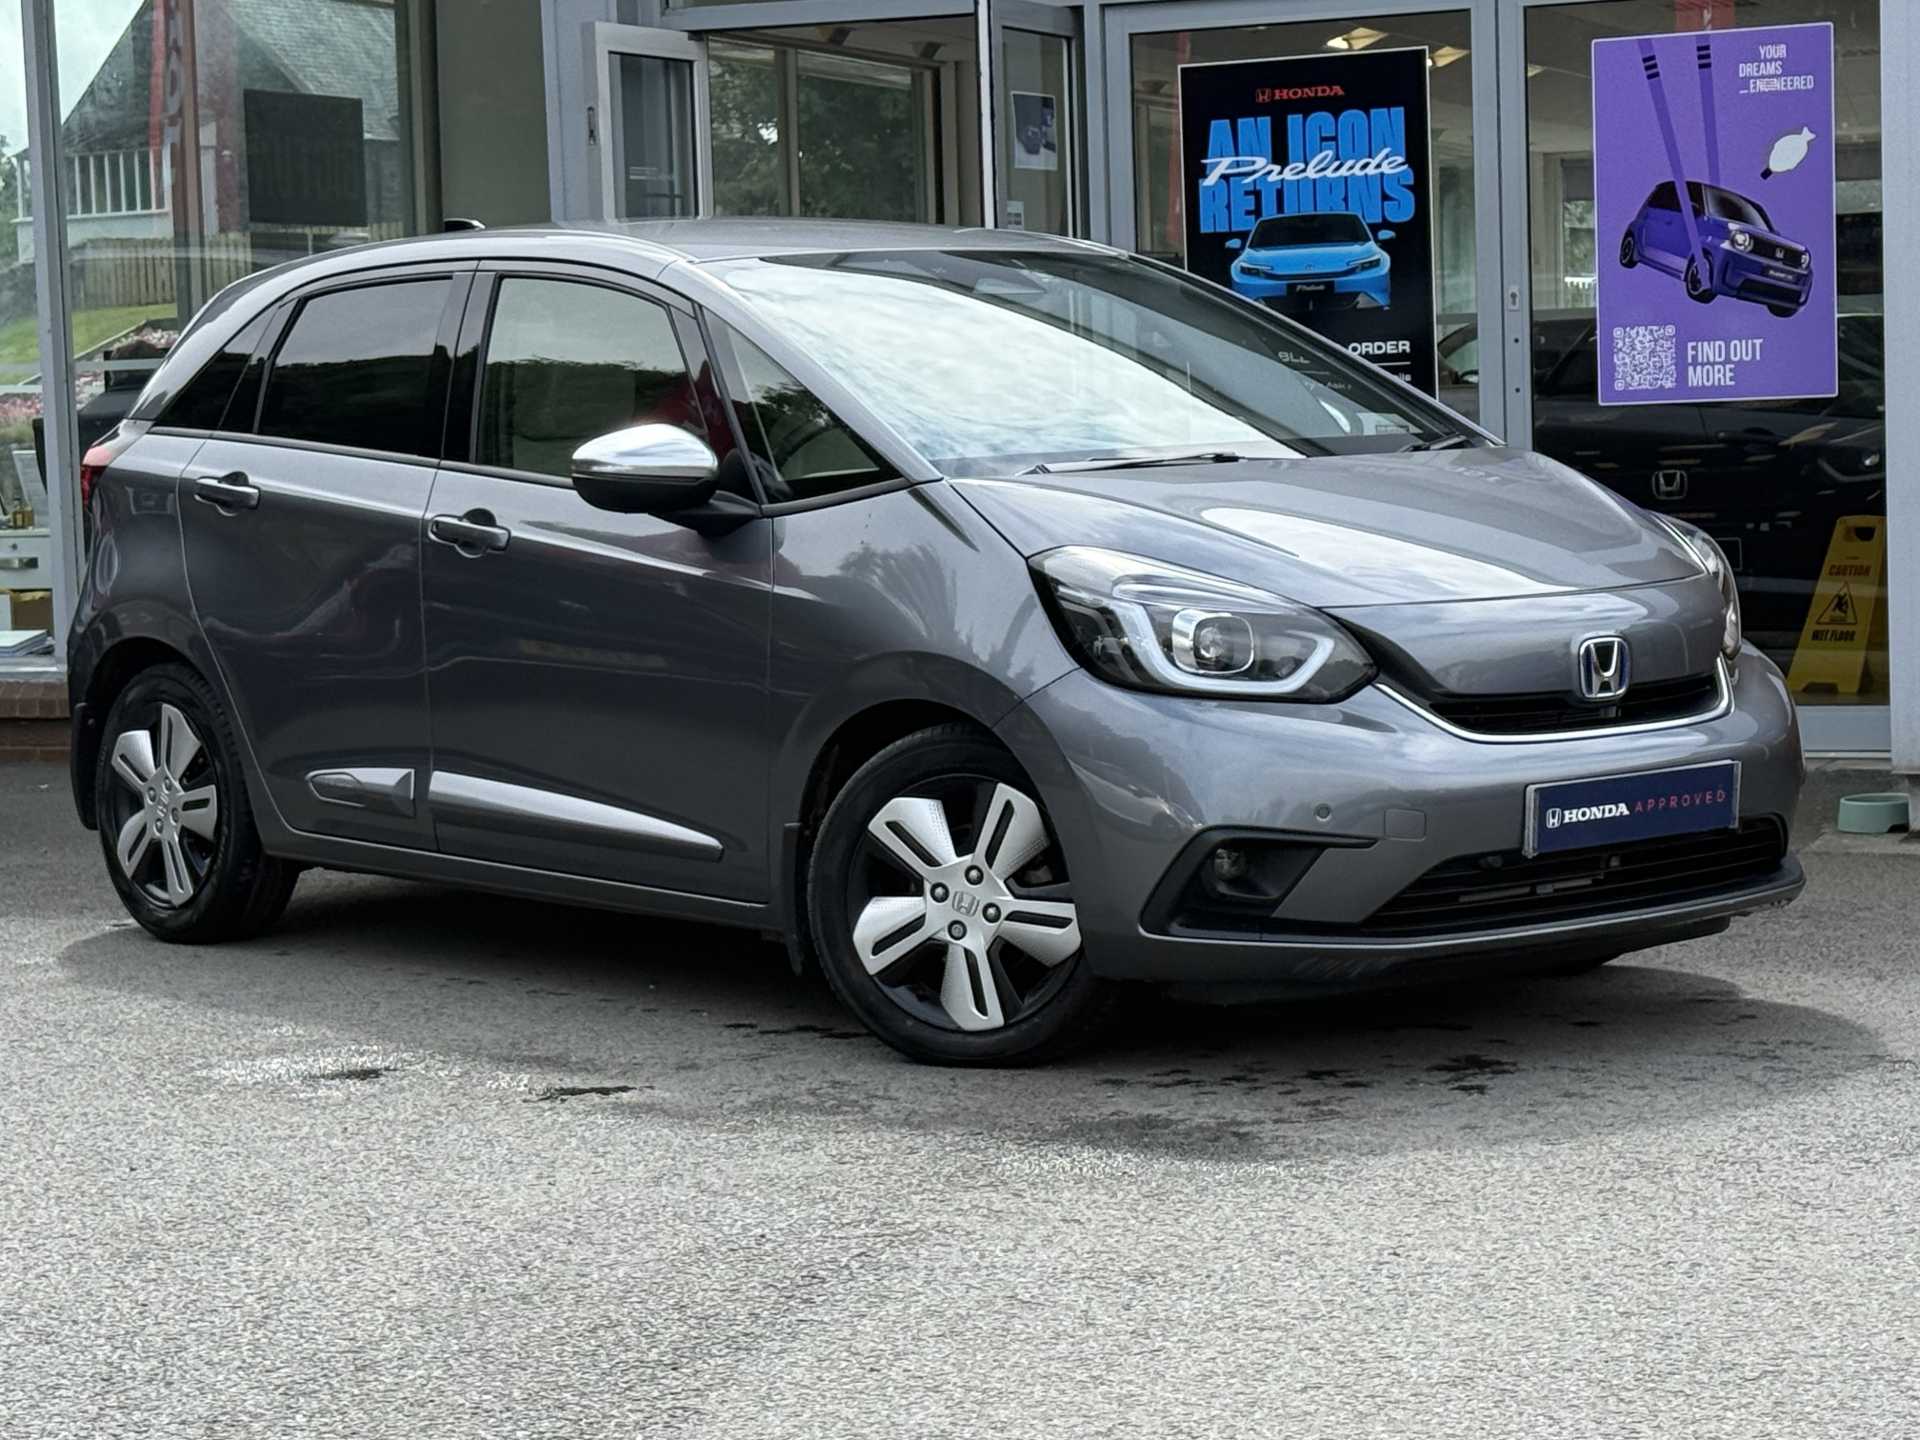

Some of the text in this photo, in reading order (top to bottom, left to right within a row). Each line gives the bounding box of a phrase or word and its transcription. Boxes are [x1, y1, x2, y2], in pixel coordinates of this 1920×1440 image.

[1759, 43, 1787, 60] YOUR
[1739, 61, 1783, 78] DREAMS
[1273, 85, 1345, 100] HONDA
[1205, 106, 1406, 175] AN ICON
[1200, 147, 1409, 187] Prelude
[1199, 167, 1415, 233] RETURNS
[1348, 340, 1411, 356] ORDER
[1687, 338, 1764, 364] FIND OUT
[1688, 364, 1736, 388] MORE
[1563, 788, 1727, 824] HONDA APPROVED
